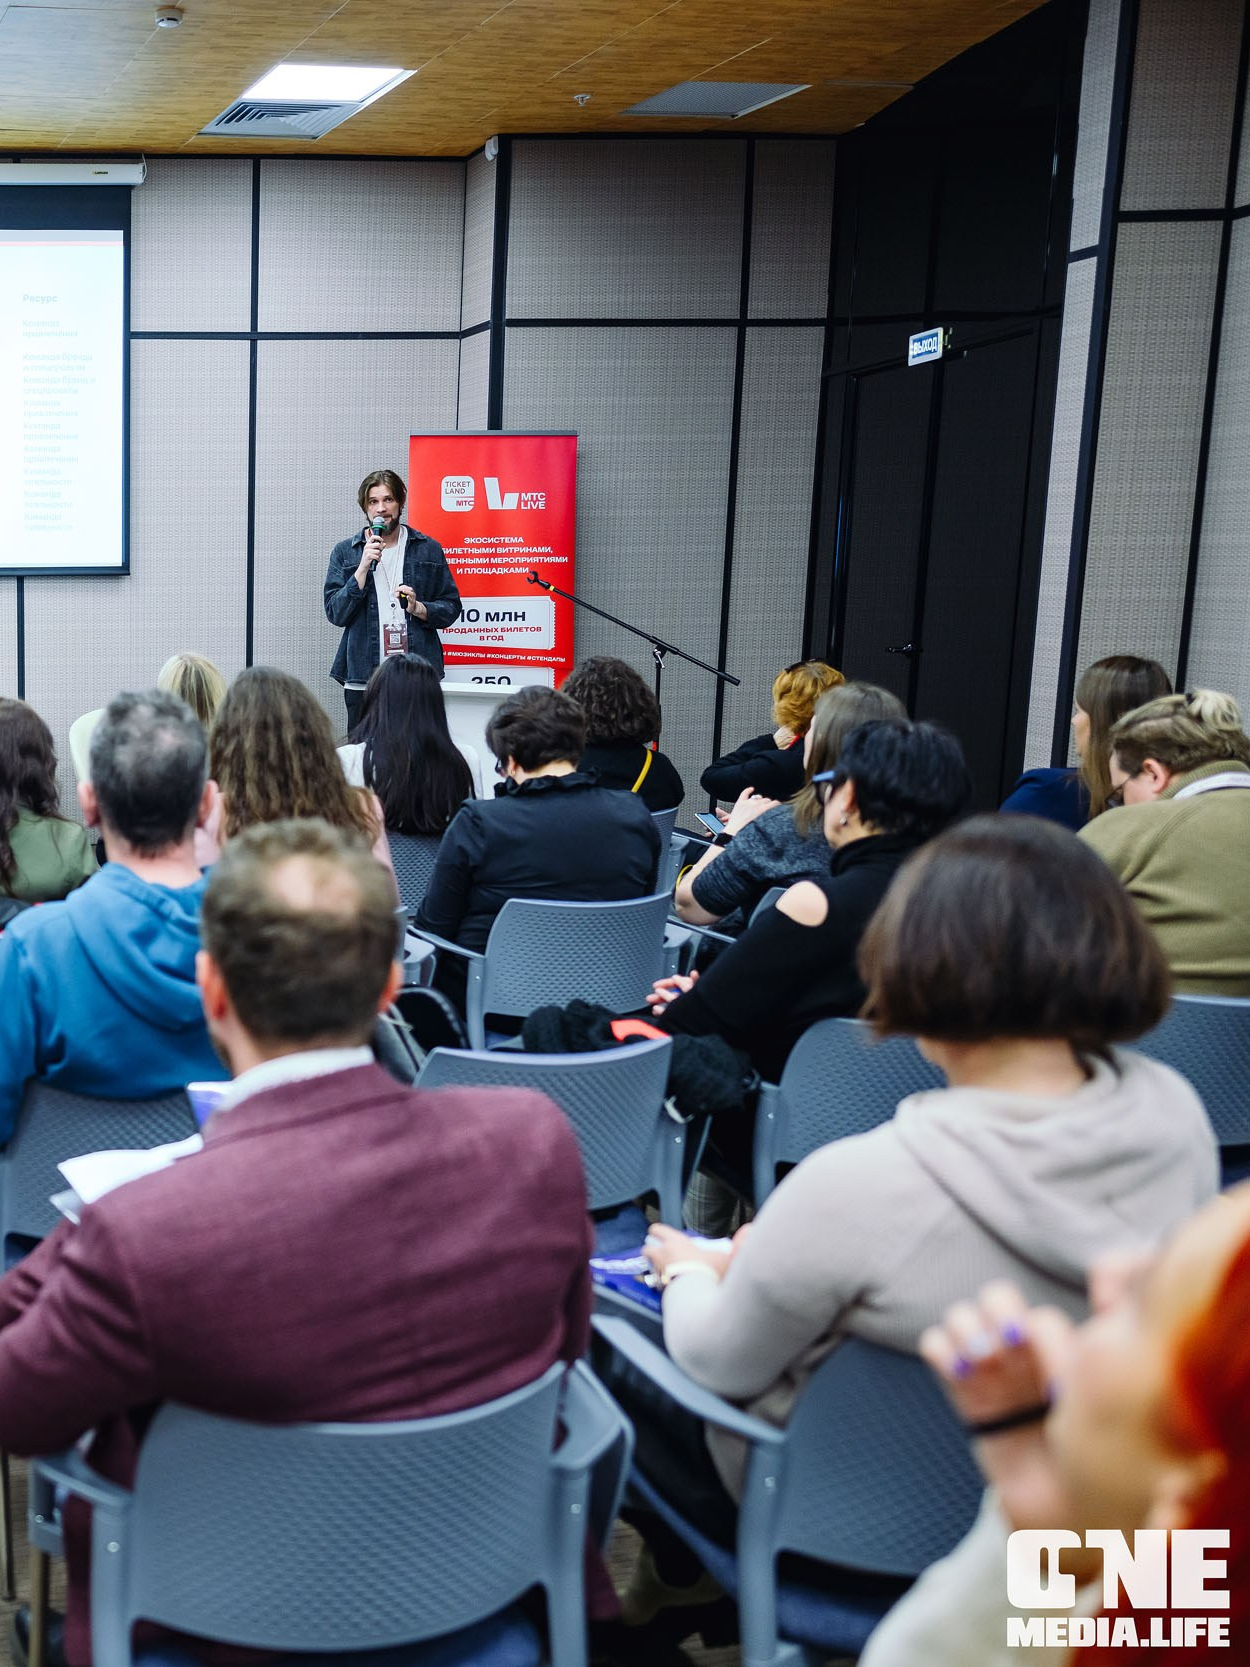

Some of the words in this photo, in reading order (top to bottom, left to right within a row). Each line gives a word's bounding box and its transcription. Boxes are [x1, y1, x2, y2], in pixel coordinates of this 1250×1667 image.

[23, 294, 58, 303] Ресурс
[913, 337, 937, 355] ВЫХОД
[521, 493, 546, 501] МТС
[521, 502, 545, 510] LIVE
[464, 567, 529, 576] ПЛОЩАДКАМИ
[461, 609, 480, 623] 10
